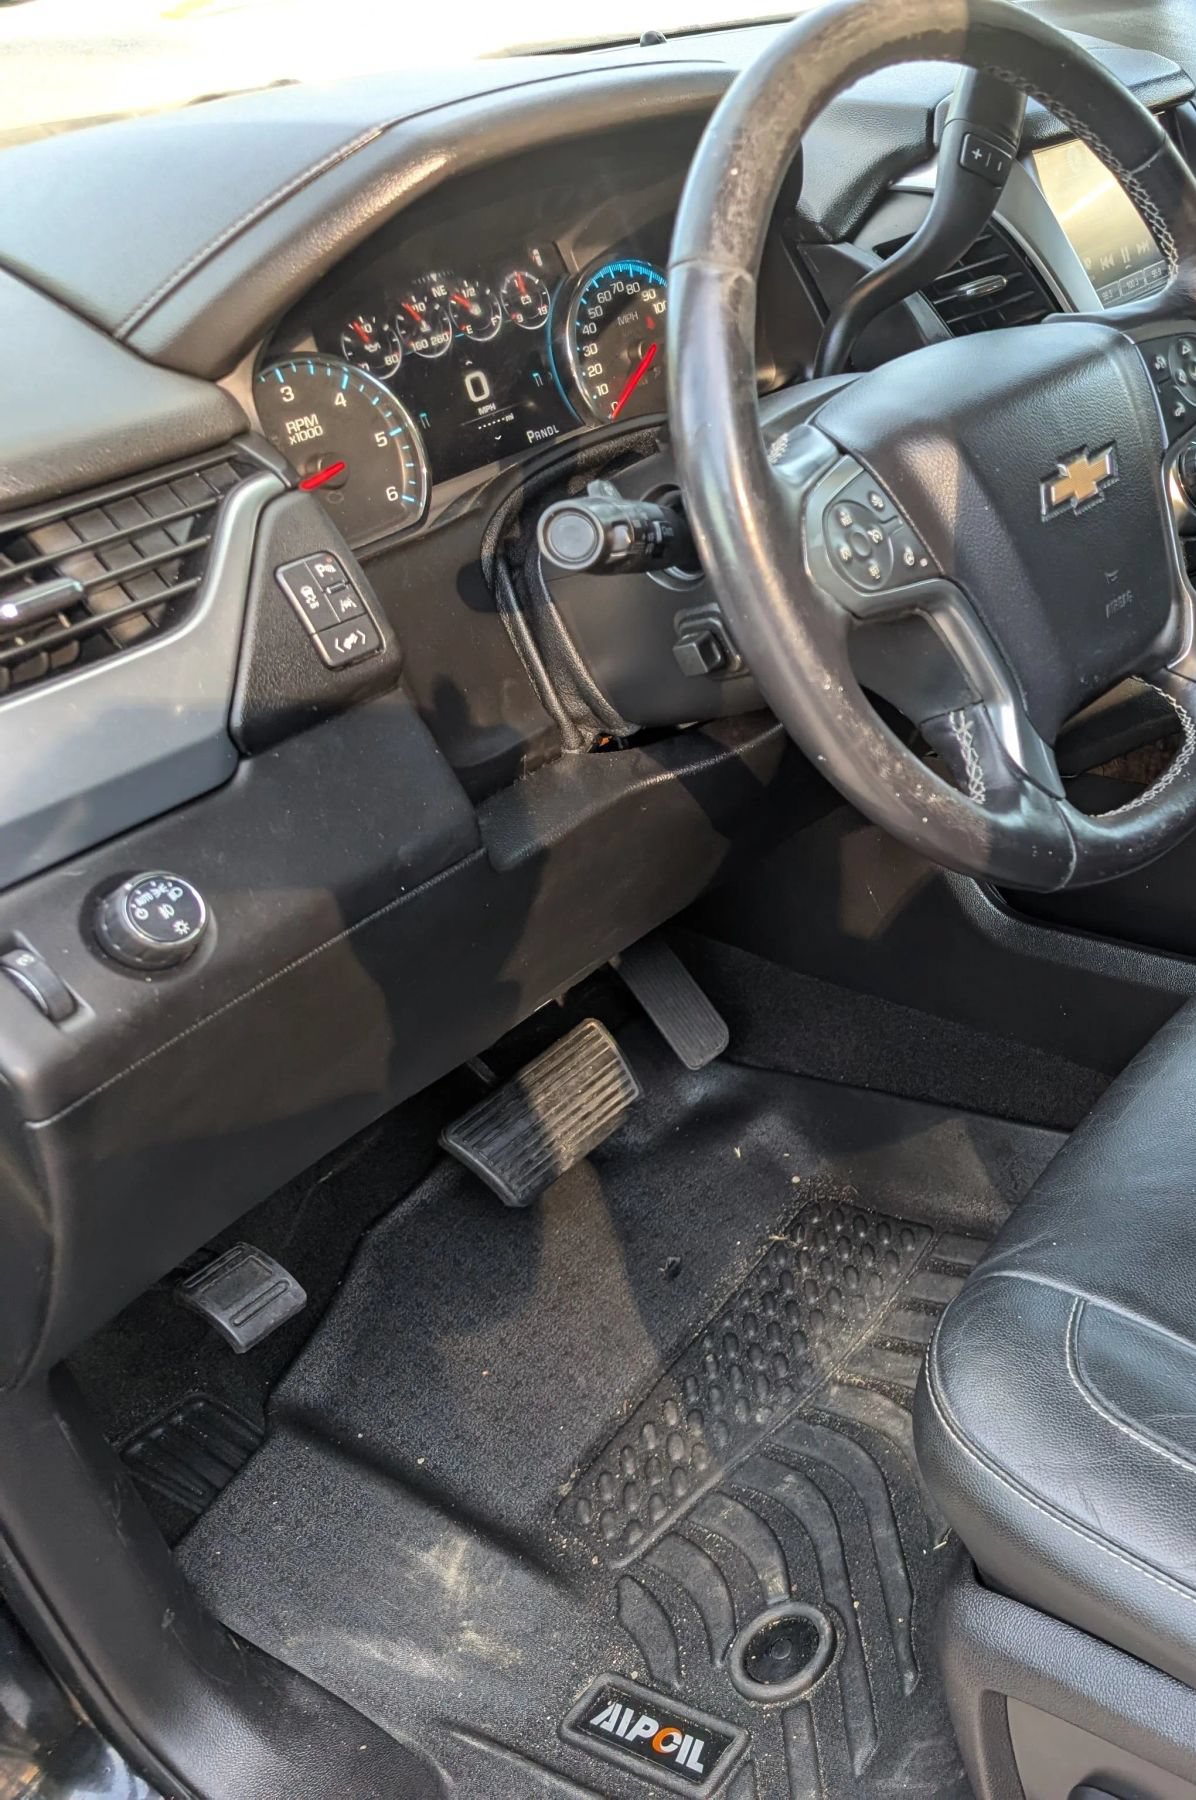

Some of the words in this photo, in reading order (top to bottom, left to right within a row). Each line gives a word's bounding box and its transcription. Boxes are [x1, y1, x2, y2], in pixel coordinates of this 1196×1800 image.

[431, 285, 448, 298] NE
[462, 287, 476, 298] 1/2
[610, 281, 625, 294] 70
[626, 282, 641, 295] 80
[596, 290, 612, 304] 60
[641, 289, 656, 301] 90
[516, 313, 524, 322] 9
[537, 306, 548, 316] 19
[588, 305, 603, 319] 50
[491, 315, 500, 326] F
[616, 311, 639, 327] MPH
[466, 325, 474, 335] E
[582, 322, 597, 335] 40
[430, 332, 449, 346] 260
[582, 343, 598, 357] 30
[384, 353, 399, 366] 80
[587, 363, 603, 378] 20
[465, 371, 490, 402] 0
[596, 383, 609, 397] 10
[280, 386, 295, 402] 3
[334, 392, 347, 408] 4
[478, 402, 496, 415] MPH
[285, 413, 319, 435] RPM
[288, 425, 324, 446] x1000
[374, 431, 388, 447] 5
[385, 486, 399, 502] 6
